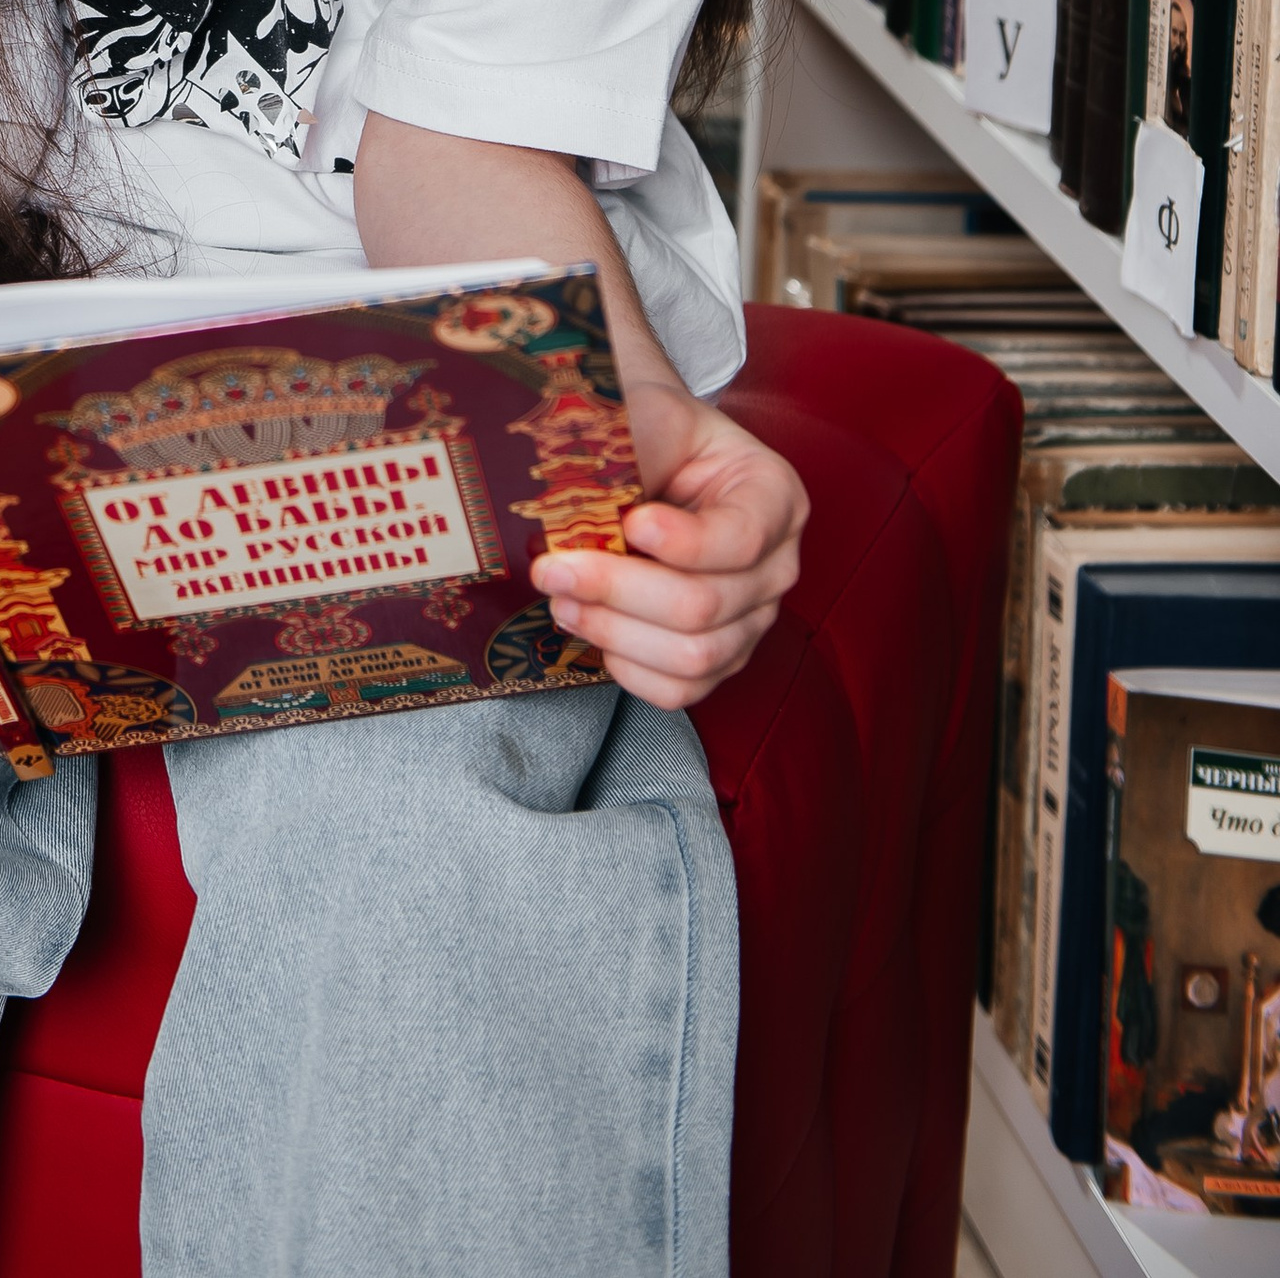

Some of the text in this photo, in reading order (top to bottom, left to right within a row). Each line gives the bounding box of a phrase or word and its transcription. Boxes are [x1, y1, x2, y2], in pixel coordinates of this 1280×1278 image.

[1158, 196, 1180, 253] Ф
[104, 455, 442, 523] ОТ ДЕВИЦЫ
[134, 509, 451, 580] МИР РУССКОЙ
[142, 518, 215, 552] ДО
[170, 546, 430, 602] ЖЕНЩИНЫ
[238, 655, 439, 692] ОТ ПЕЧИ ДО ПОРОГА
[250, 649, 404, 680] БАБЬЯ ДОРОГА
[1195, 763, 1280, 794] ЧЕРНЫ
[1211, 806, 1264, 835] Что
